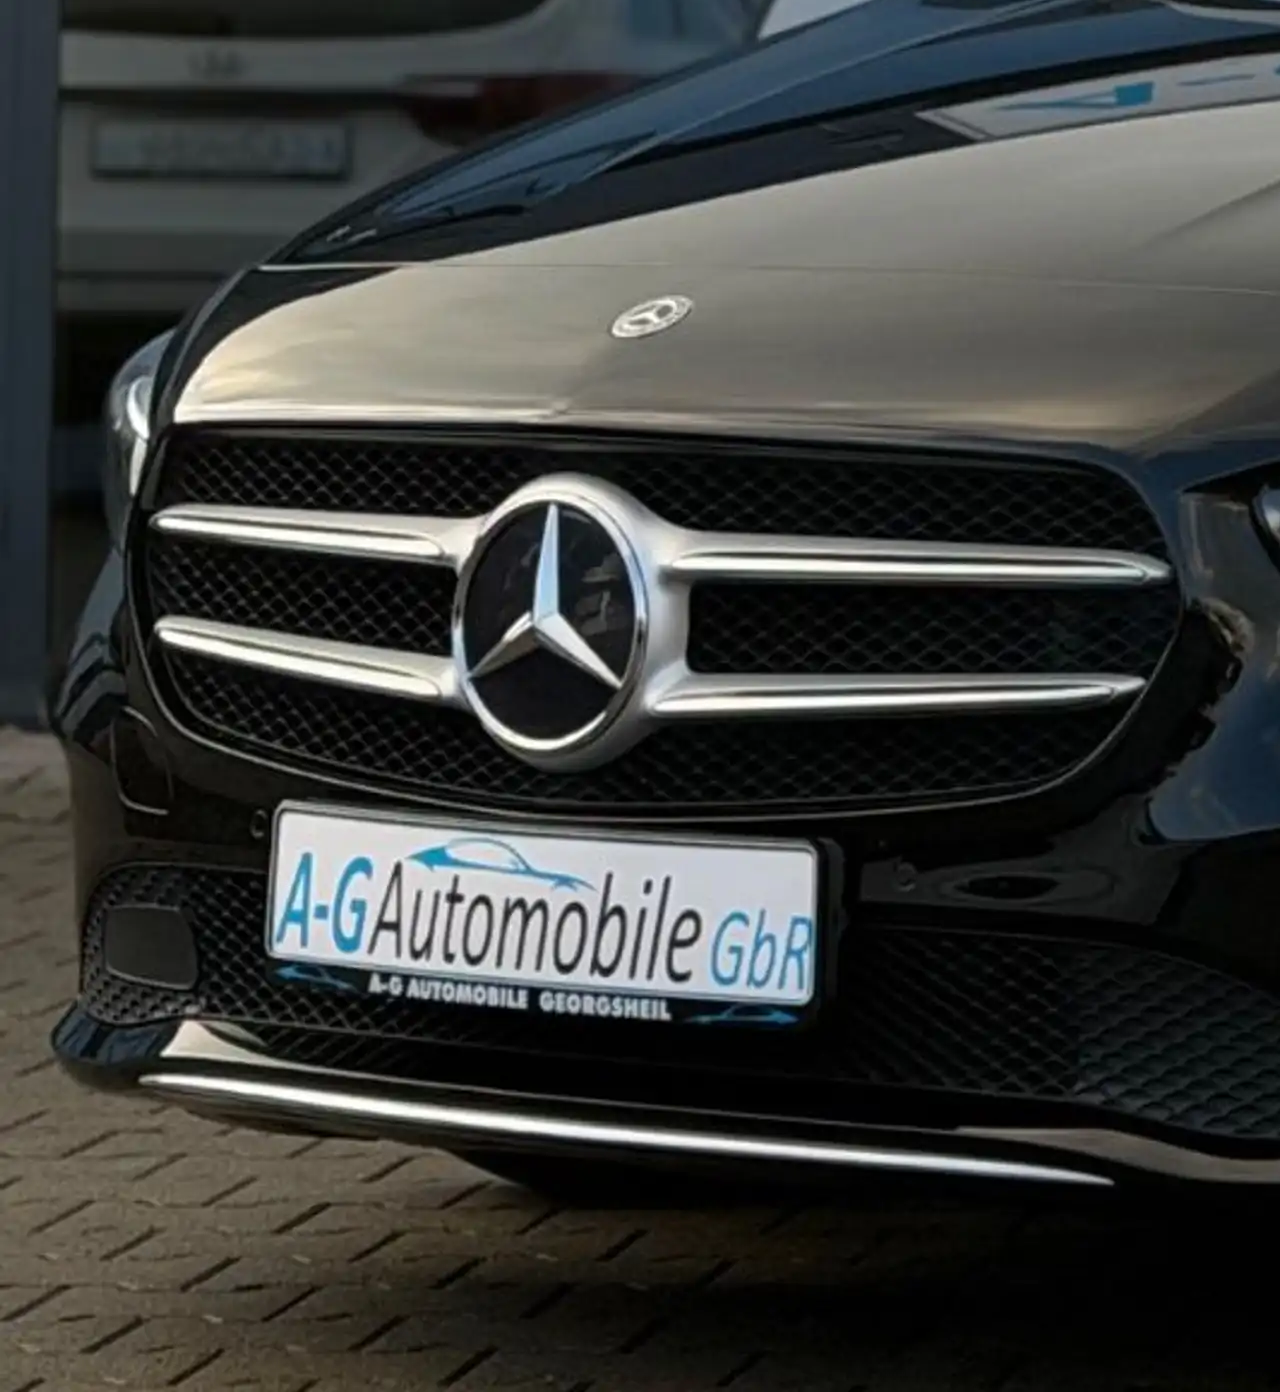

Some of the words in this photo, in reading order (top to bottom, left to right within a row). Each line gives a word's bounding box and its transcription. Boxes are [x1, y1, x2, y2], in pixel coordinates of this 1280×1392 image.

[711, 908, 812, 990] GbR
[368, 973, 402, 995] A-G
[406, 979, 529, 1009] AUTOMOBILE
[539, 991, 672, 1021] GEORGSHEIL
